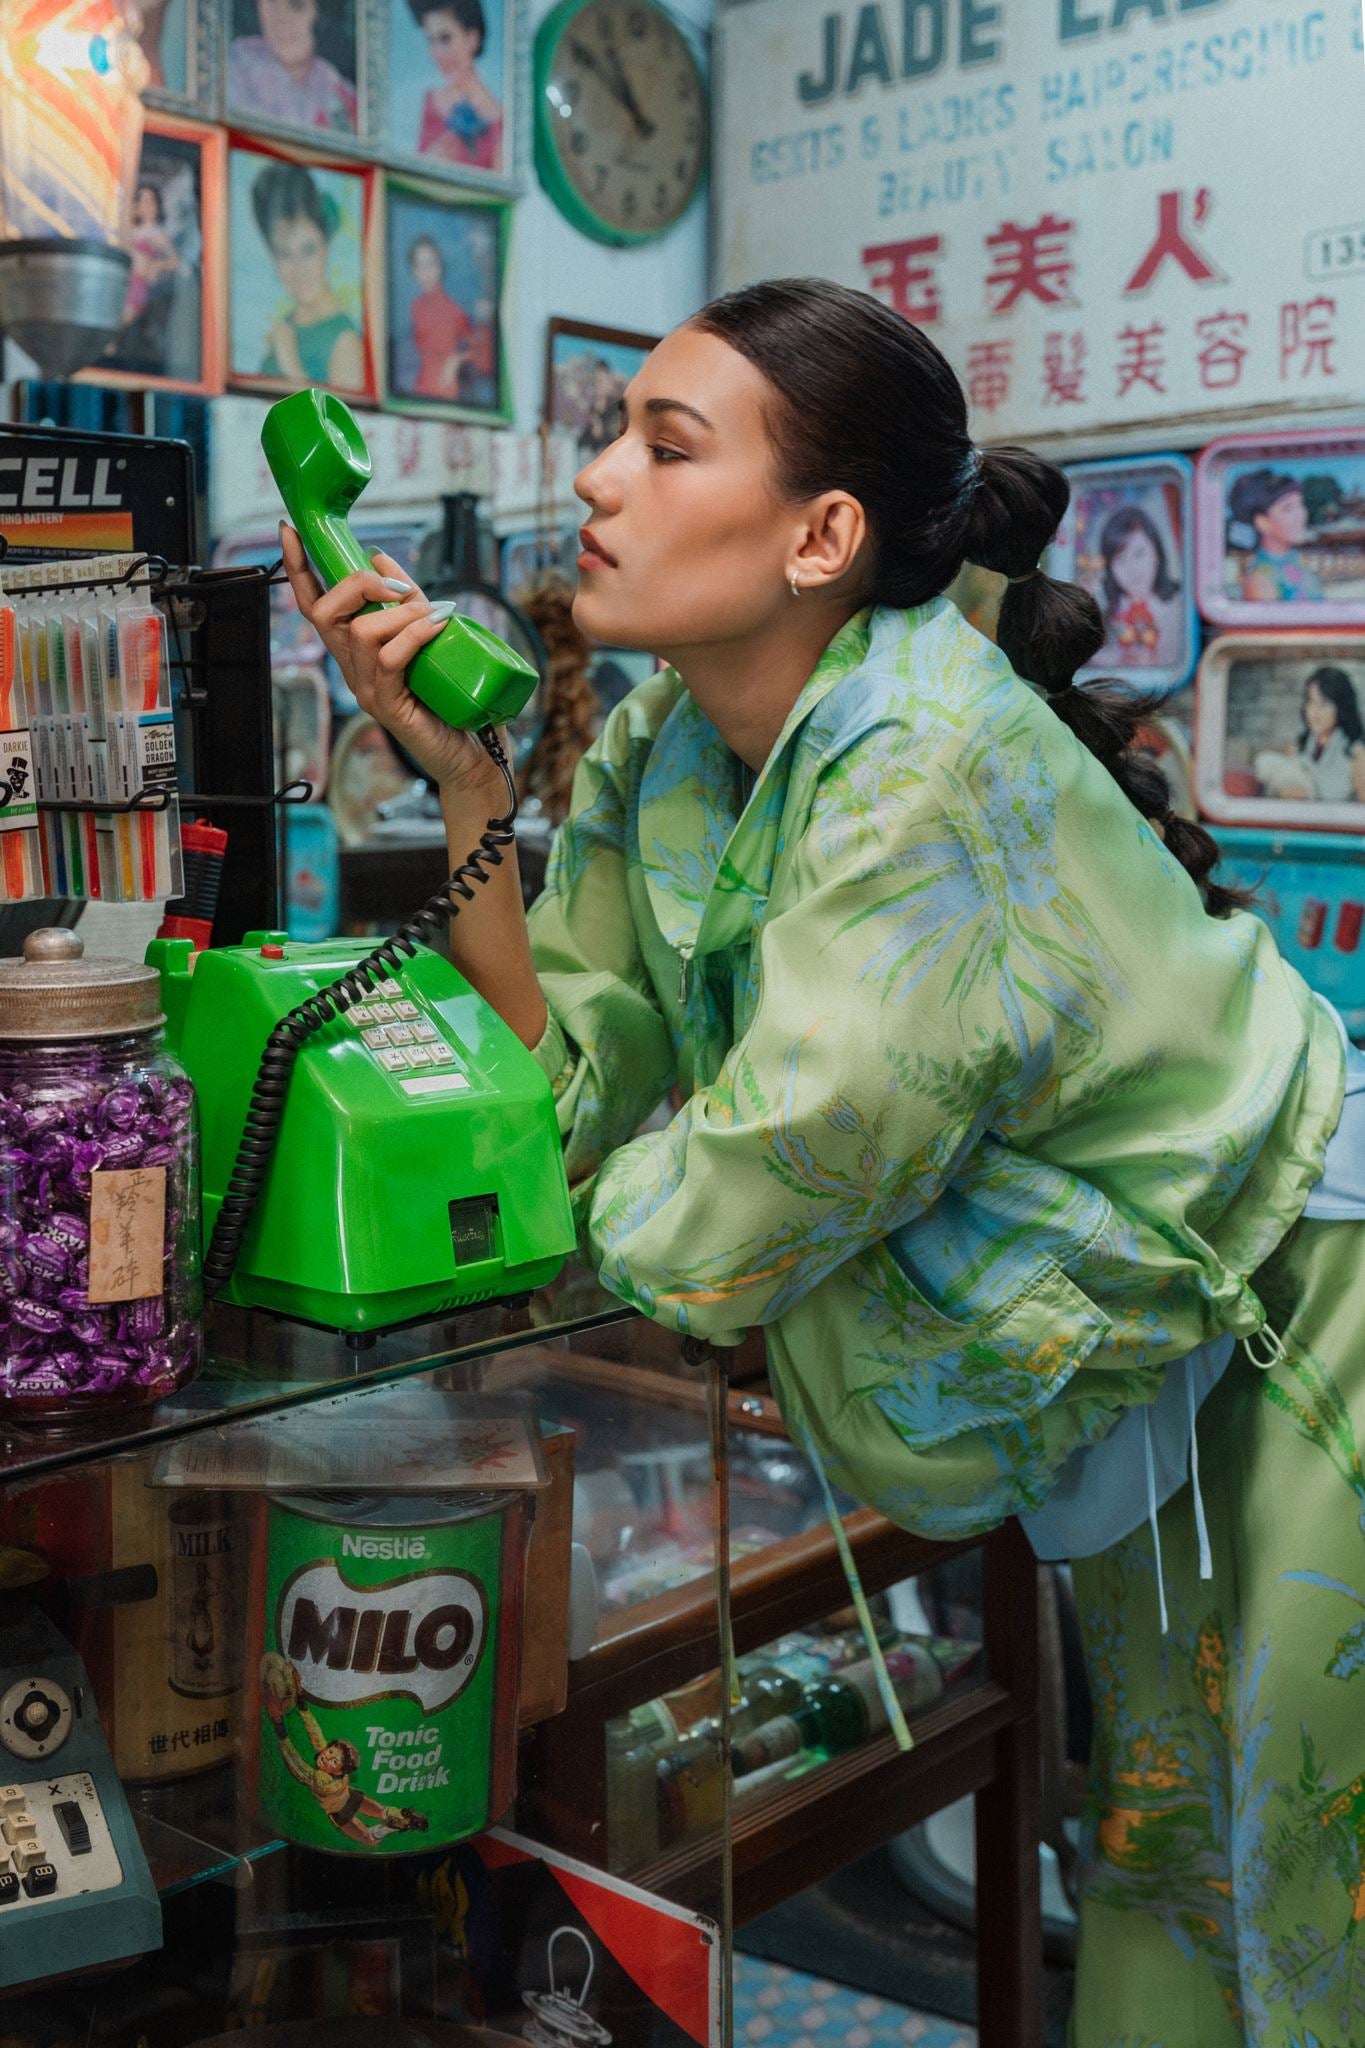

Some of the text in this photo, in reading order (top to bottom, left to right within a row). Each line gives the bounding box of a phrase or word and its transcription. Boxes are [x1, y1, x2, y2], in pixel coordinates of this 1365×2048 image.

[798, 0, 1000, 104] JADE
[3, 741, 28, 753] DARKIE
[145, 739, 174, 752] GOLDEN
[145, 751, 175, 764] DRAGON
[177, 1527, 232, 1557] MILK
[342, 1534, 426, 1559] Nestlé
[288, 1597, 475, 1675] MILO
[365, 1724, 440, 1748] Tonic
[371, 1744, 441, 1771] Food
[376, 1766, 449, 1795] Drink
